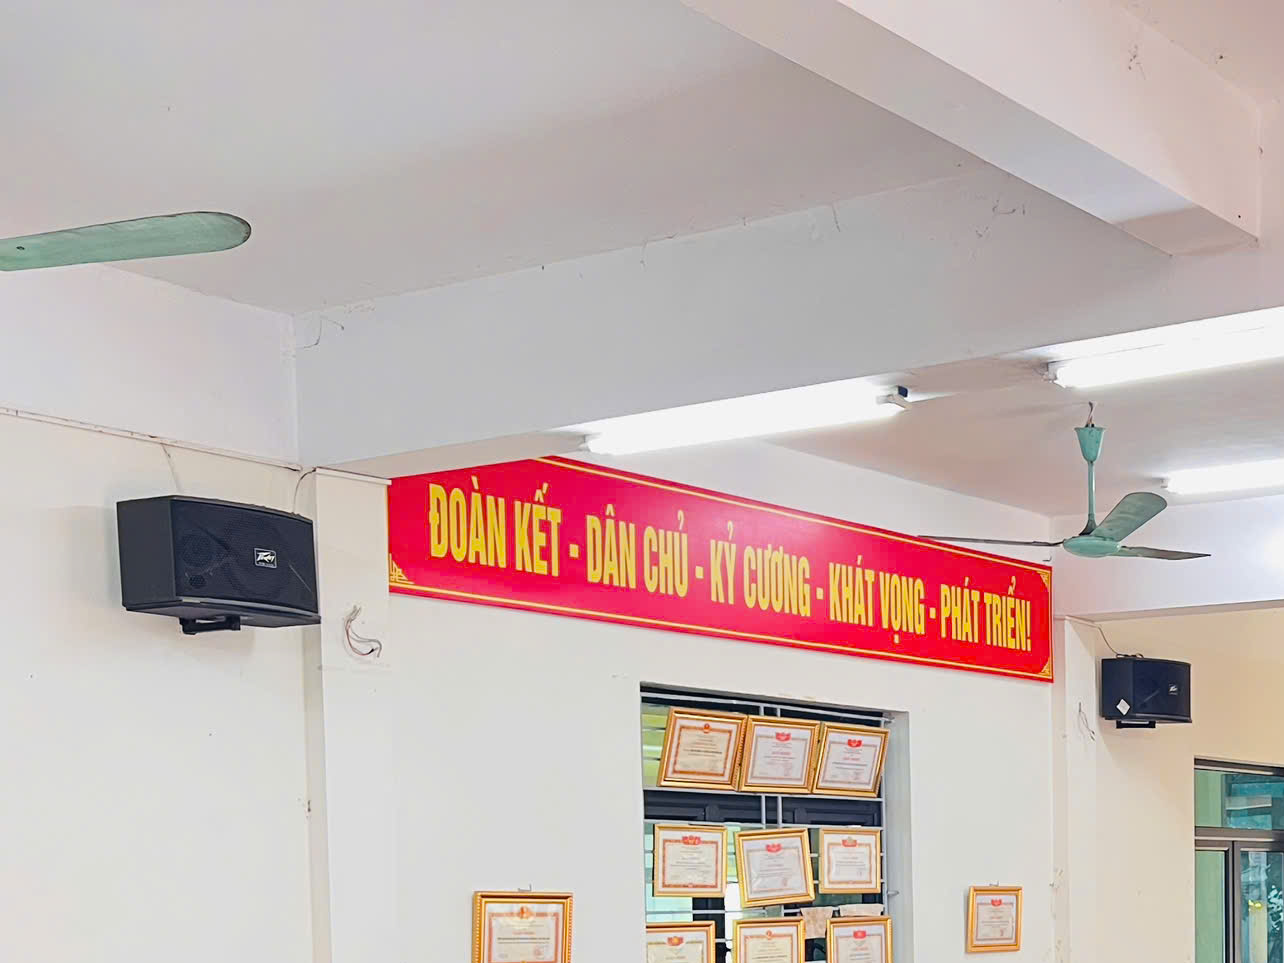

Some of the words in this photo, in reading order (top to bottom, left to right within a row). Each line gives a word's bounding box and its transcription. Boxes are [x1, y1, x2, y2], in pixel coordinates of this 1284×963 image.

[429, 476, 507, 568] ĐOÀN
[514, 482, 562, 577] KẾT
[586, 504, 636, 589] DÂN
[643, 510, 688, 598] CHỦ
[710, 520, 737, 605] KỶ
[743, 544, 811, 617] CƯƠNG
[829, 555, 875, 627] KHÁT
[879, 571, 925, 644] VỌNG
[940, 576, 980, 643] PHÁT
[983, 575, 1032, 652] TRIỂN!
